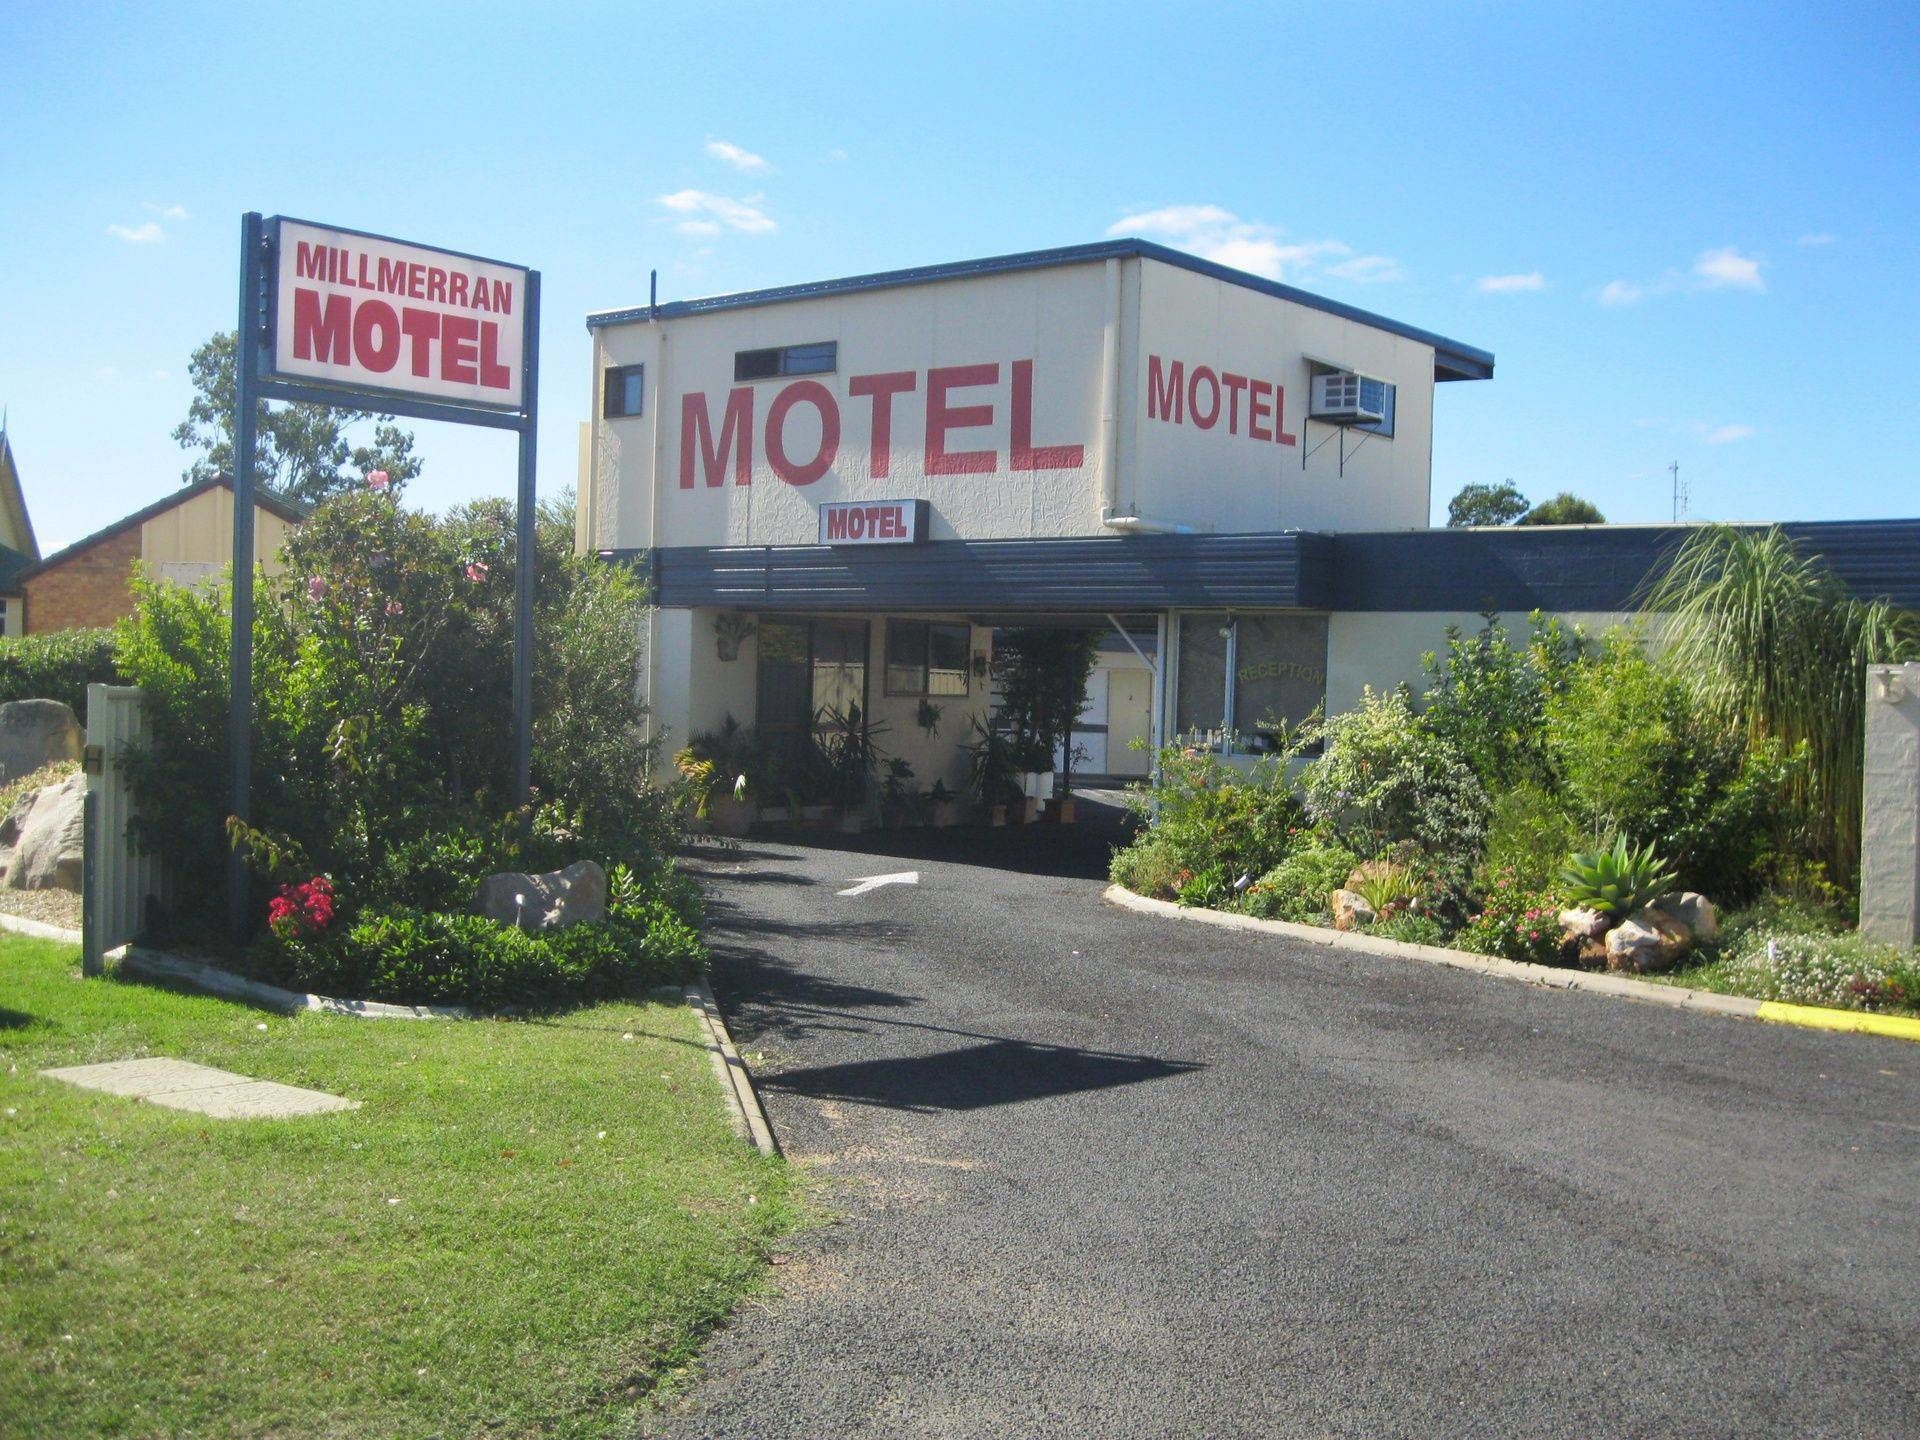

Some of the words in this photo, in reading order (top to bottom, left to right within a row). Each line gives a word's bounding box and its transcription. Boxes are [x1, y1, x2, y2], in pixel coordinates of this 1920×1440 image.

[296, 241, 512, 315] MILLMERRAN
[293, 287, 510, 390] MOTEL
[679, 358, 1085, 489] MOTEL
[1148, 354, 1296, 447] MOTEL
[827, 506, 907, 540] MOTEL
[1238, 660, 1324, 686] RECEPTION
